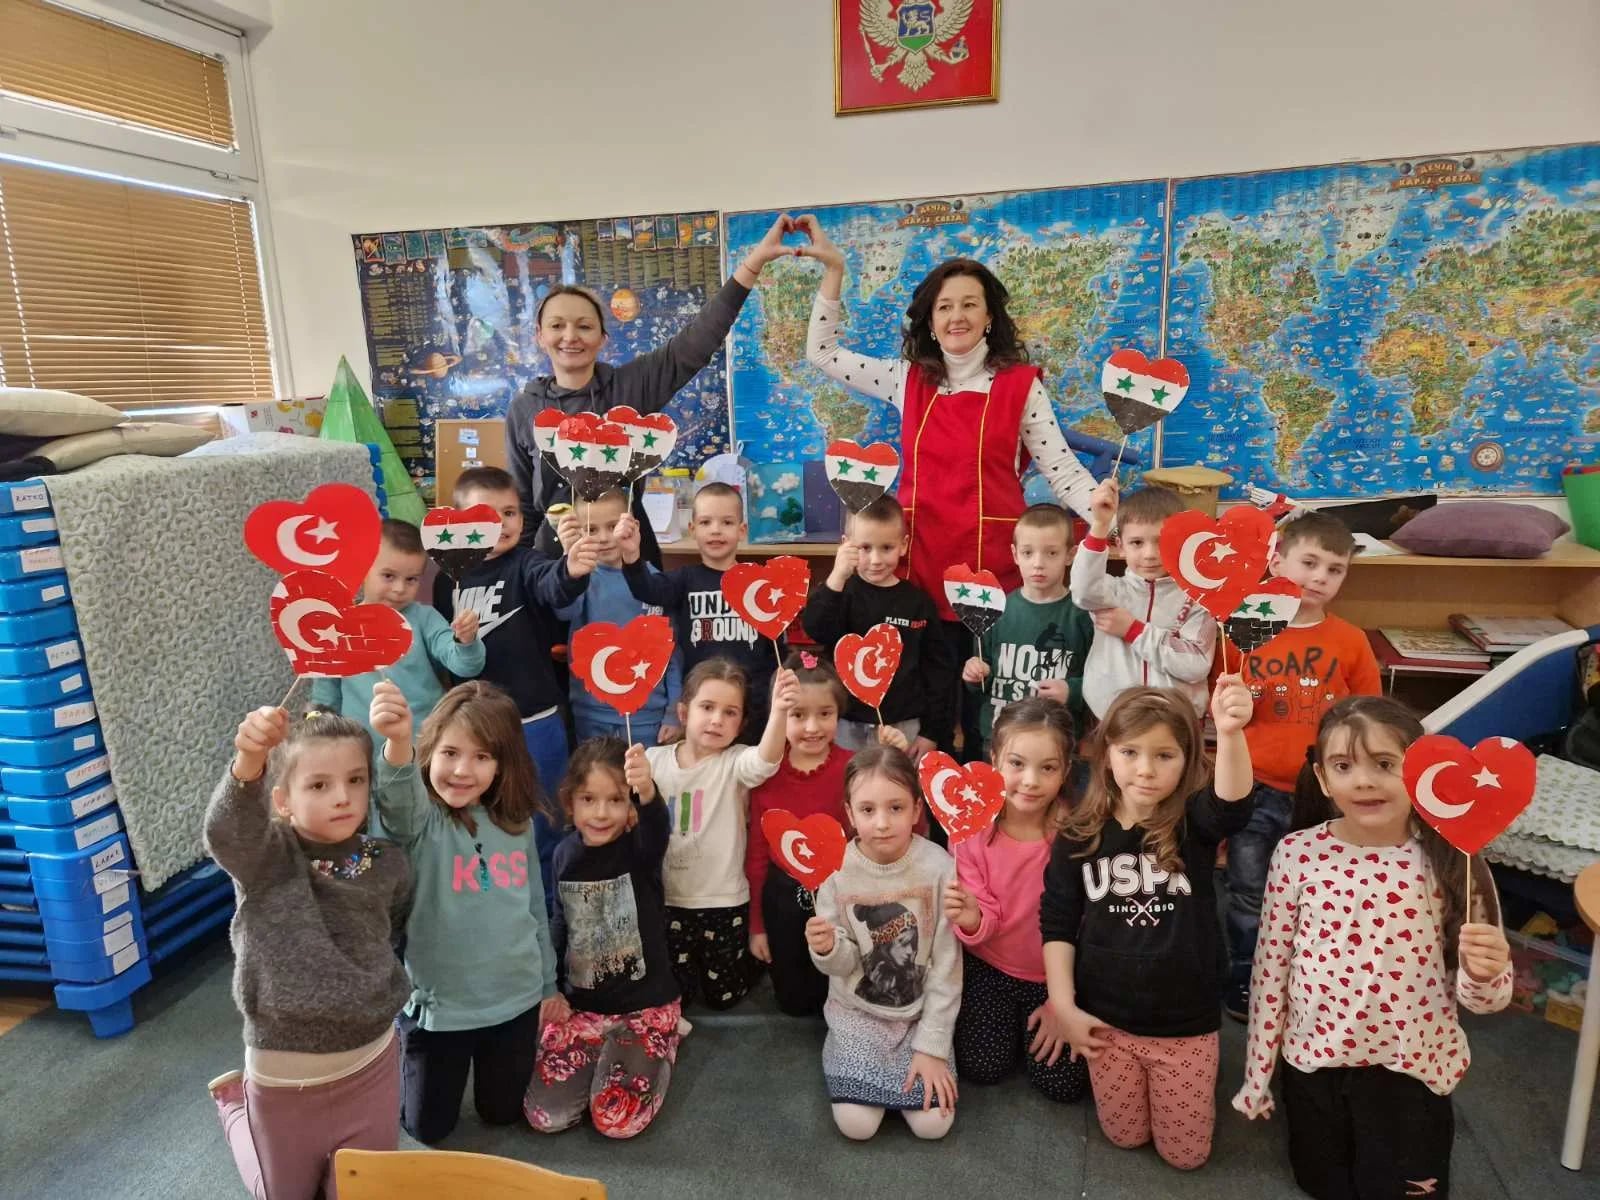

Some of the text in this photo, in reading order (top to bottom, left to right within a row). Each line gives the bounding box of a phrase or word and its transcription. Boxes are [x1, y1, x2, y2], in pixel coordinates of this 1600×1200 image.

[885, 616, 910, 627] PLAYER
[690, 617, 759, 648] GROUND
[1081, 852, 1192, 902] USPA
[1108, 904, 1144, 914] SINCE
